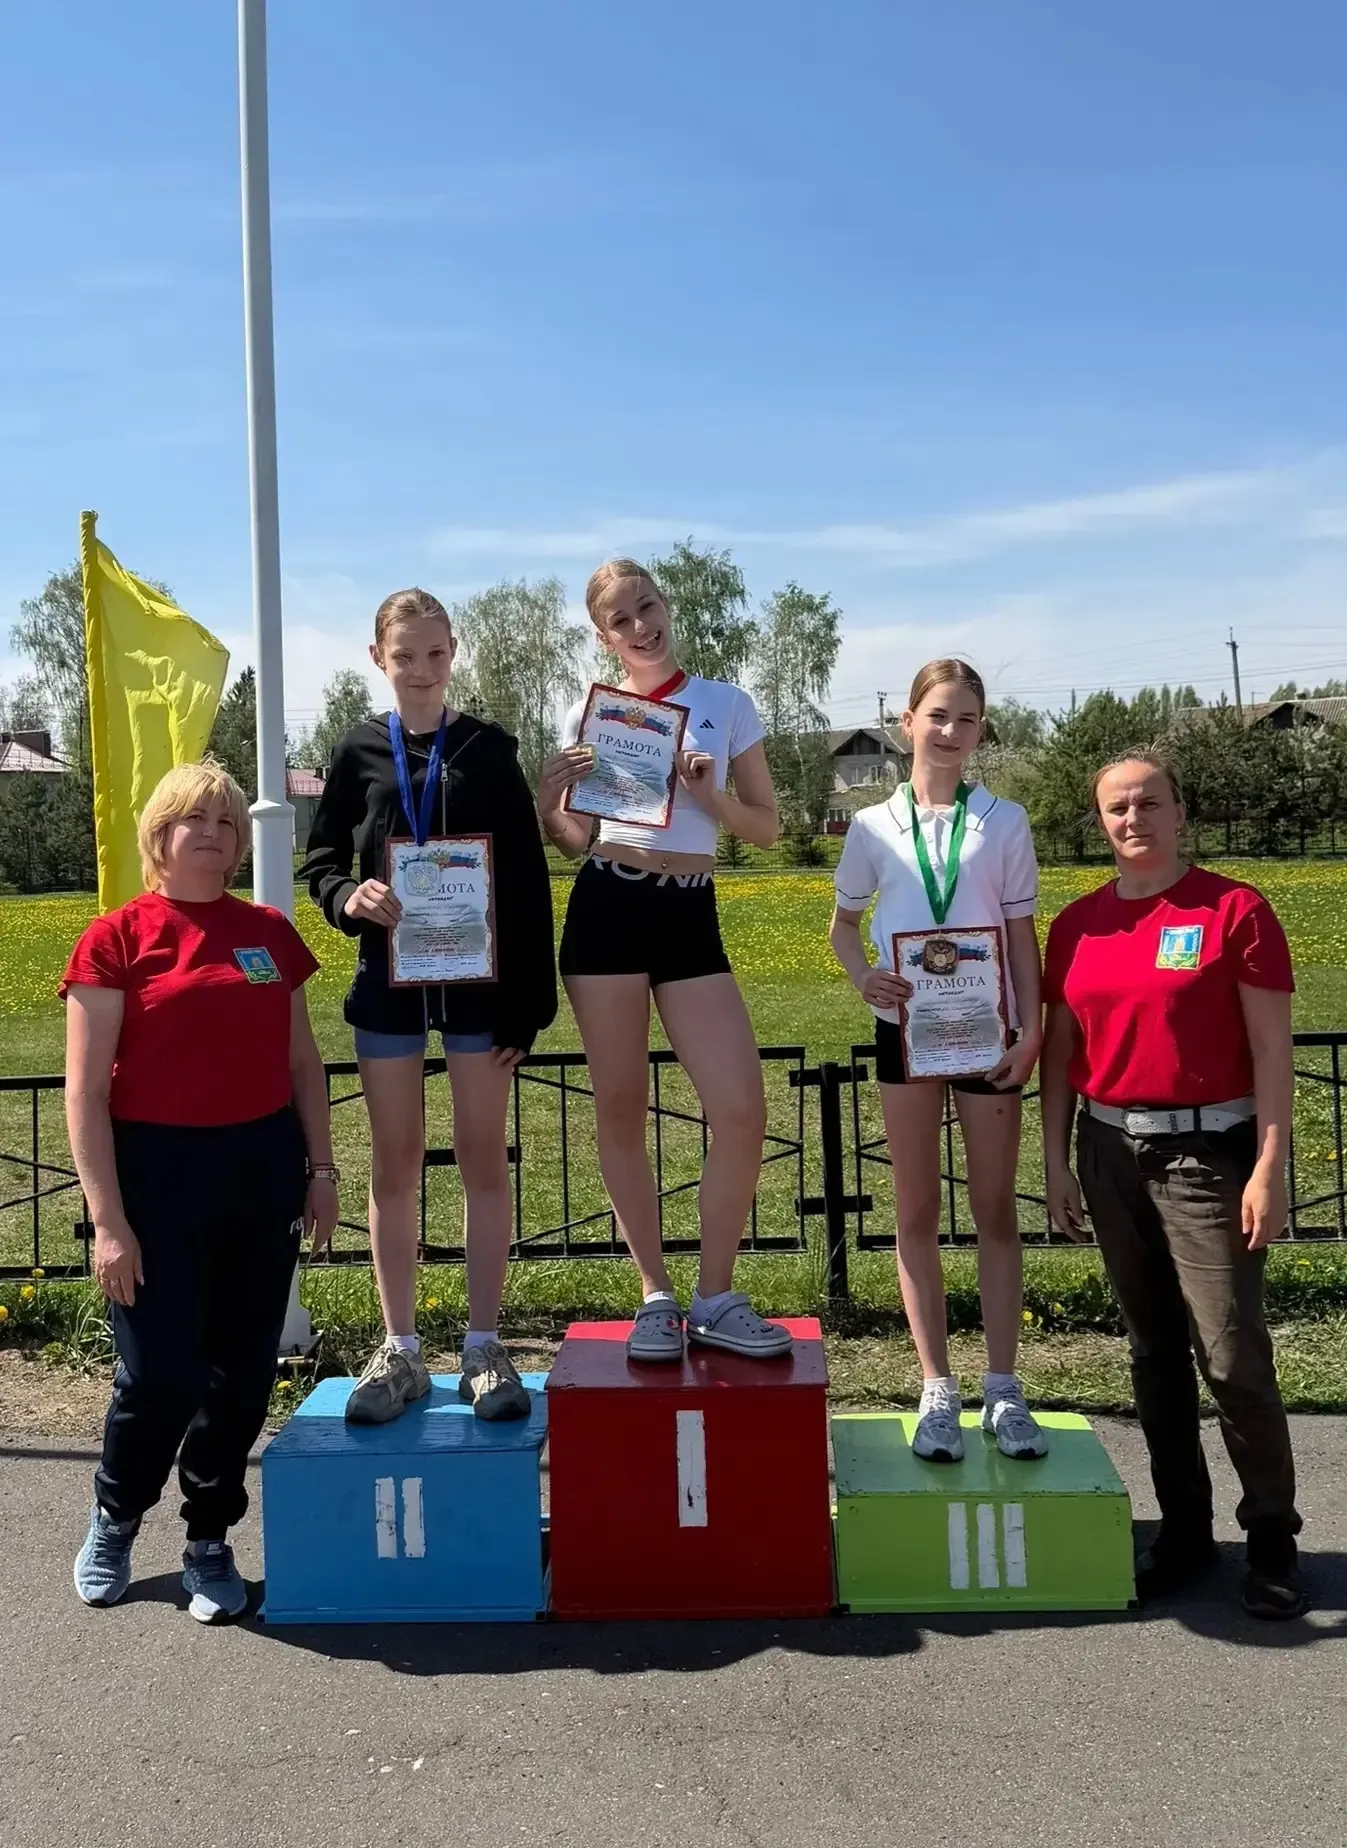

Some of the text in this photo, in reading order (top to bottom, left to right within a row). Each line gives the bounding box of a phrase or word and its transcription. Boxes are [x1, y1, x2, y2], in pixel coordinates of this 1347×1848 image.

[597, 733, 662, 757] ГРАМОТА
[916, 975, 986, 991] ГРАМОТА
[374, 1476, 426, 1559] II
[947, 1502, 1027, 1590] III
